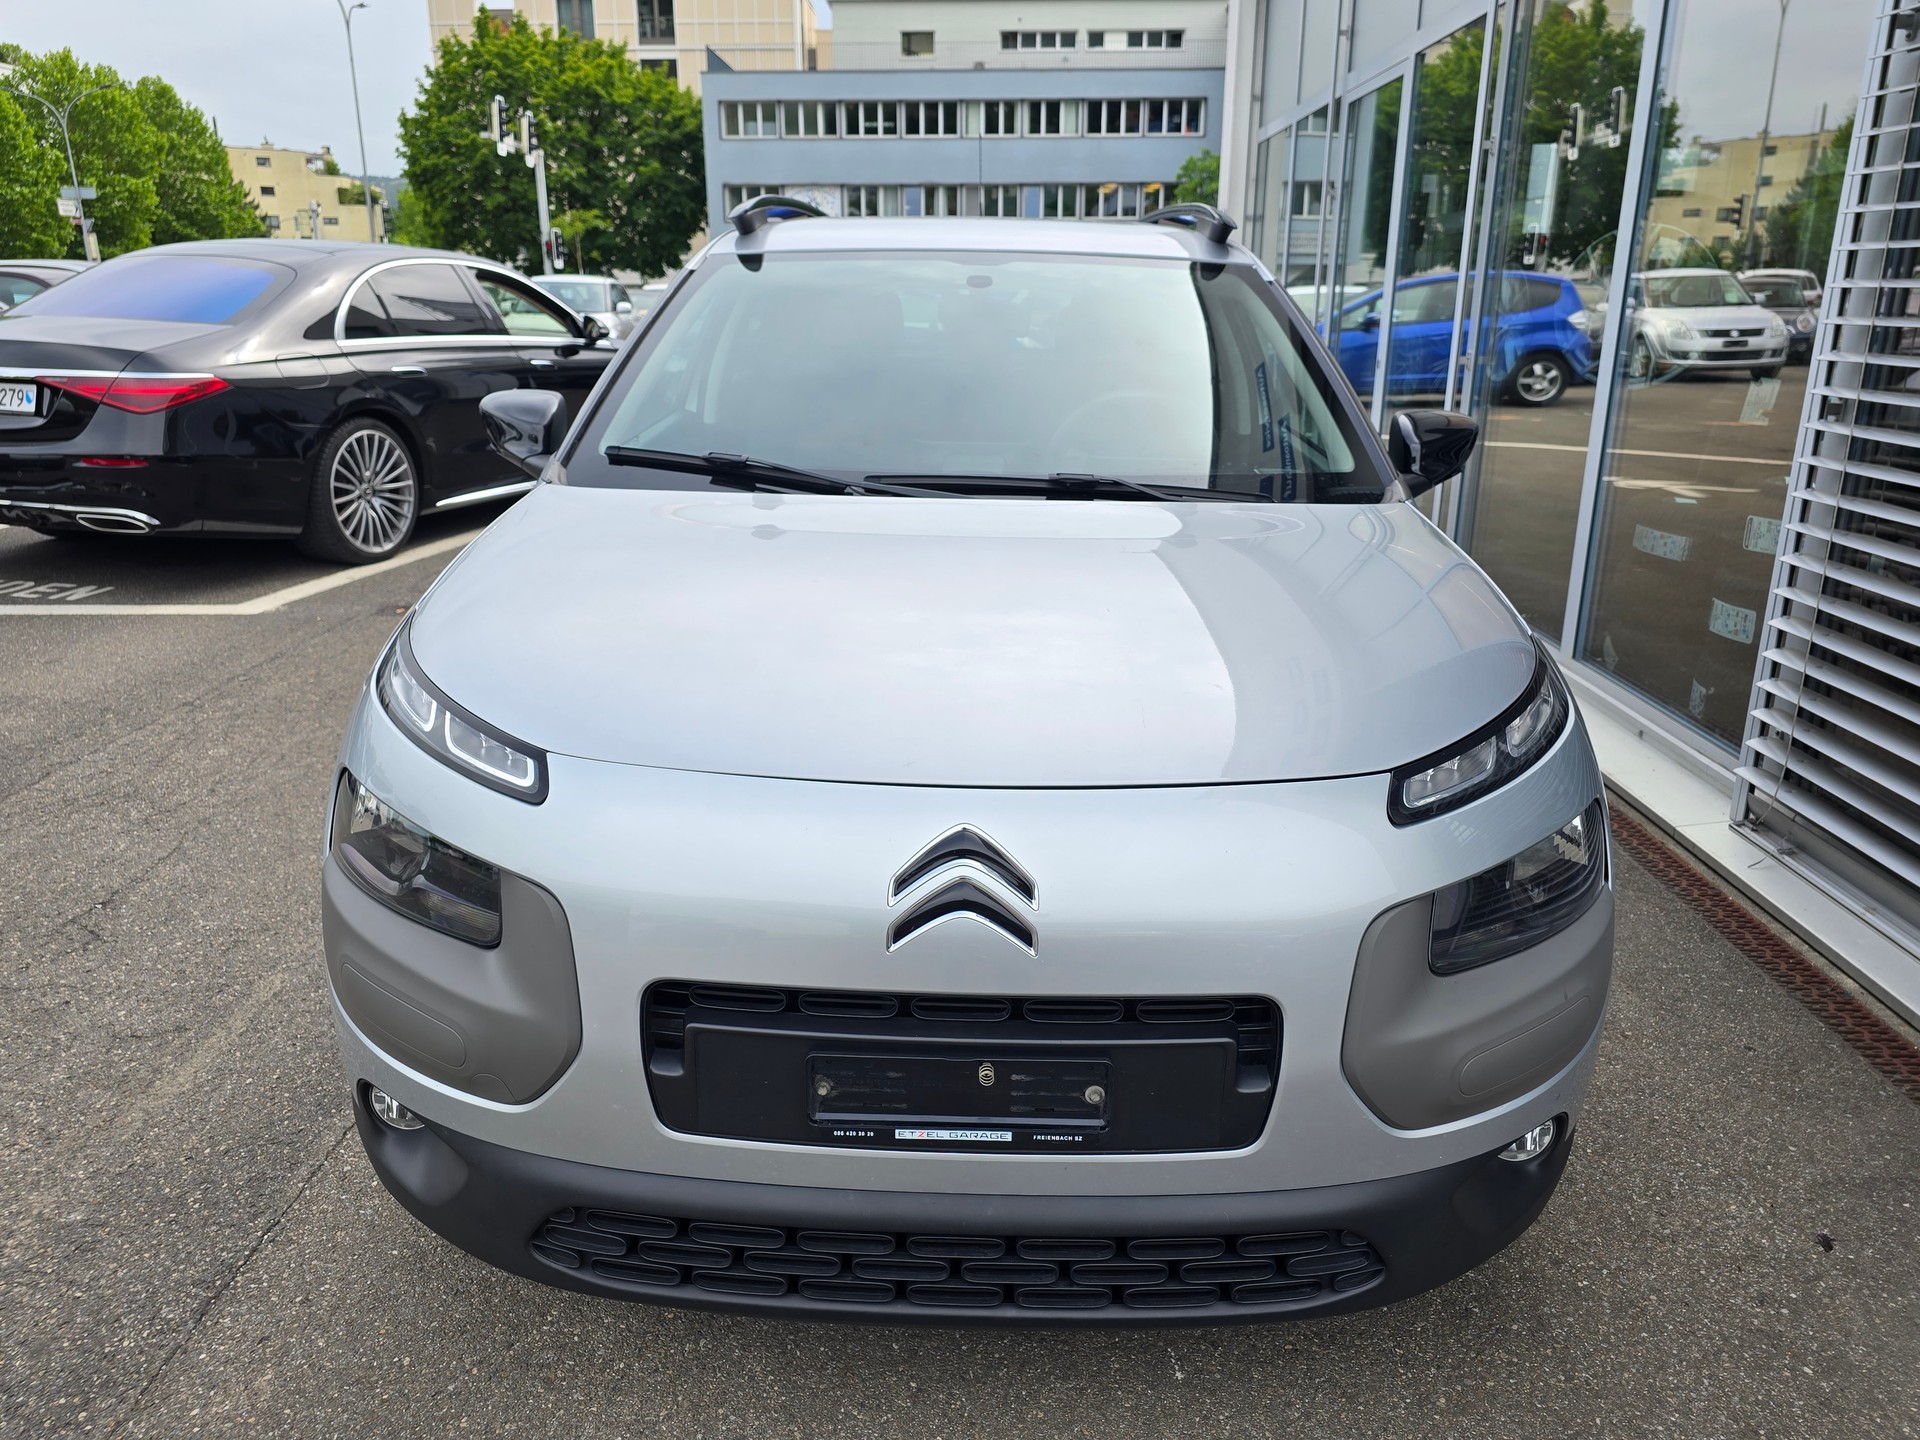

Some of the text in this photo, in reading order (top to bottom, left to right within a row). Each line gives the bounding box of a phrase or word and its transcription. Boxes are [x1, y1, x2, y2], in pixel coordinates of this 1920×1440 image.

[0, 388, 24, 408] 279
[0, 579, 115, 601] DEN
[898, 1131, 1009, 1141] ETZEL GARAGE
[1033, 1134, 1073, 1142] FREIENBACH
